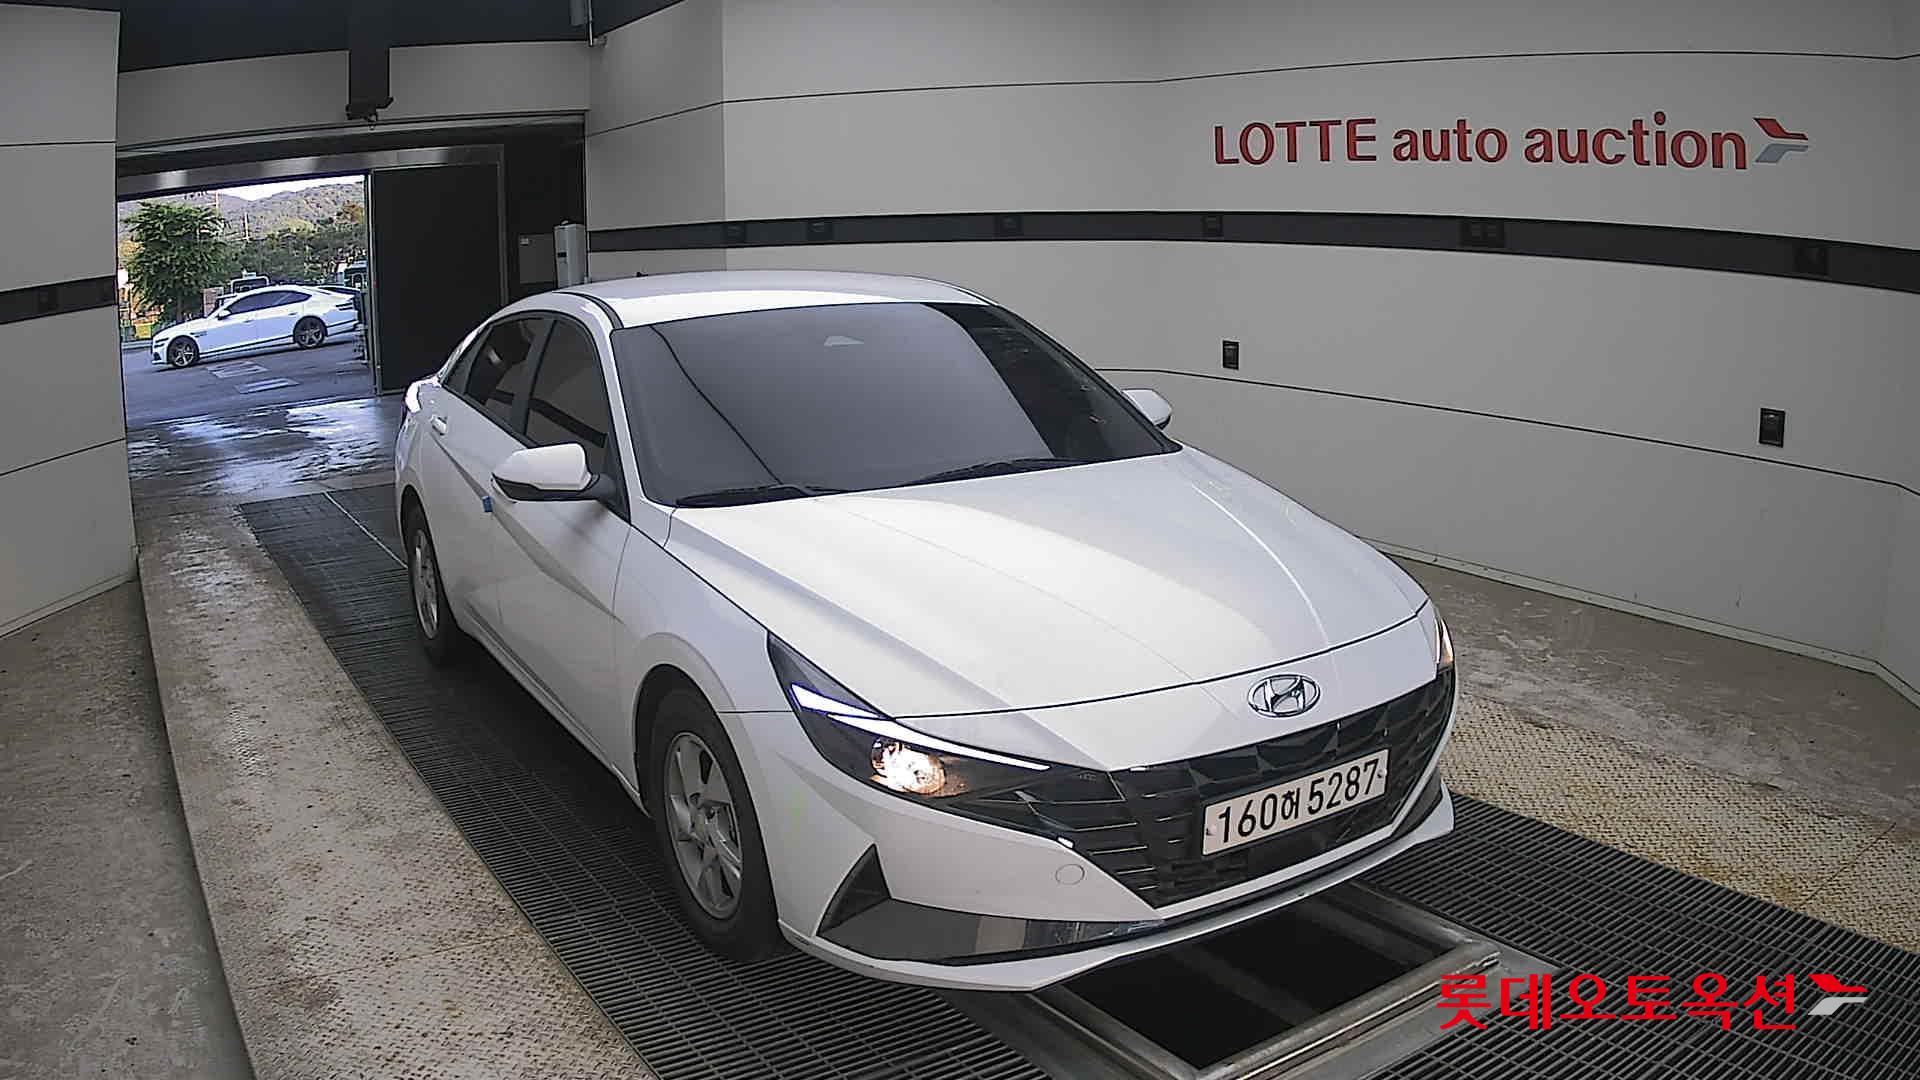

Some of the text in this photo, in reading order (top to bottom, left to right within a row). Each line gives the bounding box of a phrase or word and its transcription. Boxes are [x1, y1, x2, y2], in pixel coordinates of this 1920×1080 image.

[1214, 111, 1748, 170] LOTTE auto auction
